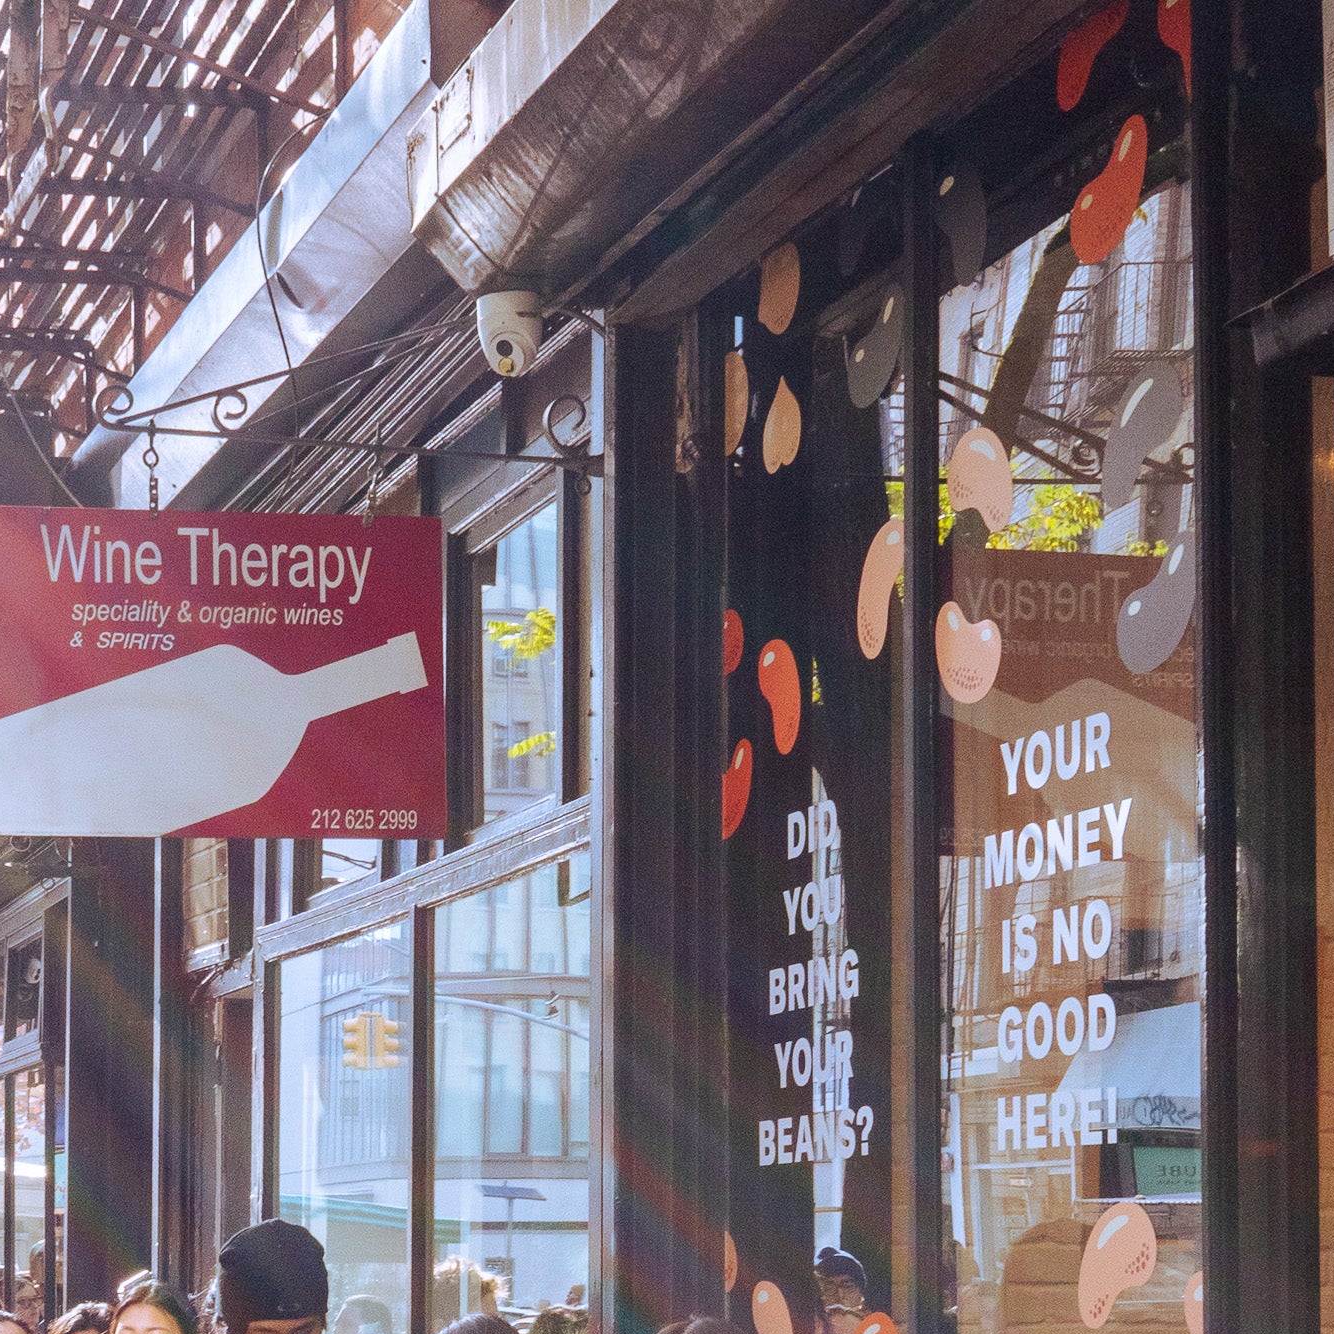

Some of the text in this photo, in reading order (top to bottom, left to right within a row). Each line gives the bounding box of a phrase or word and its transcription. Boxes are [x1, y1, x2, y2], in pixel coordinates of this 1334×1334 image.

[40, 524, 372, 604] Wine Therapy
[70, 631, 175, 651] & SPIRITS
[71, 600, 343, 629] speciality & organic wines
[1001, 712, 1112, 795] YOUR
[311, 808, 418, 831] 212 625 2999
[787, 799, 839, 860] DID
[984, 798, 1133, 890] MONEY
[783, 875, 842, 936] YOU
[1002, 899, 1113, 974] IS NO
[769, 948, 860, 1016] BRING
[774, 1030, 854, 1089] YOUR
[997, 993, 1117, 1064] GOOD
[759, 1105, 874, 1167] BEANS?
[997, 1087, 1118, 1151] HERE!
